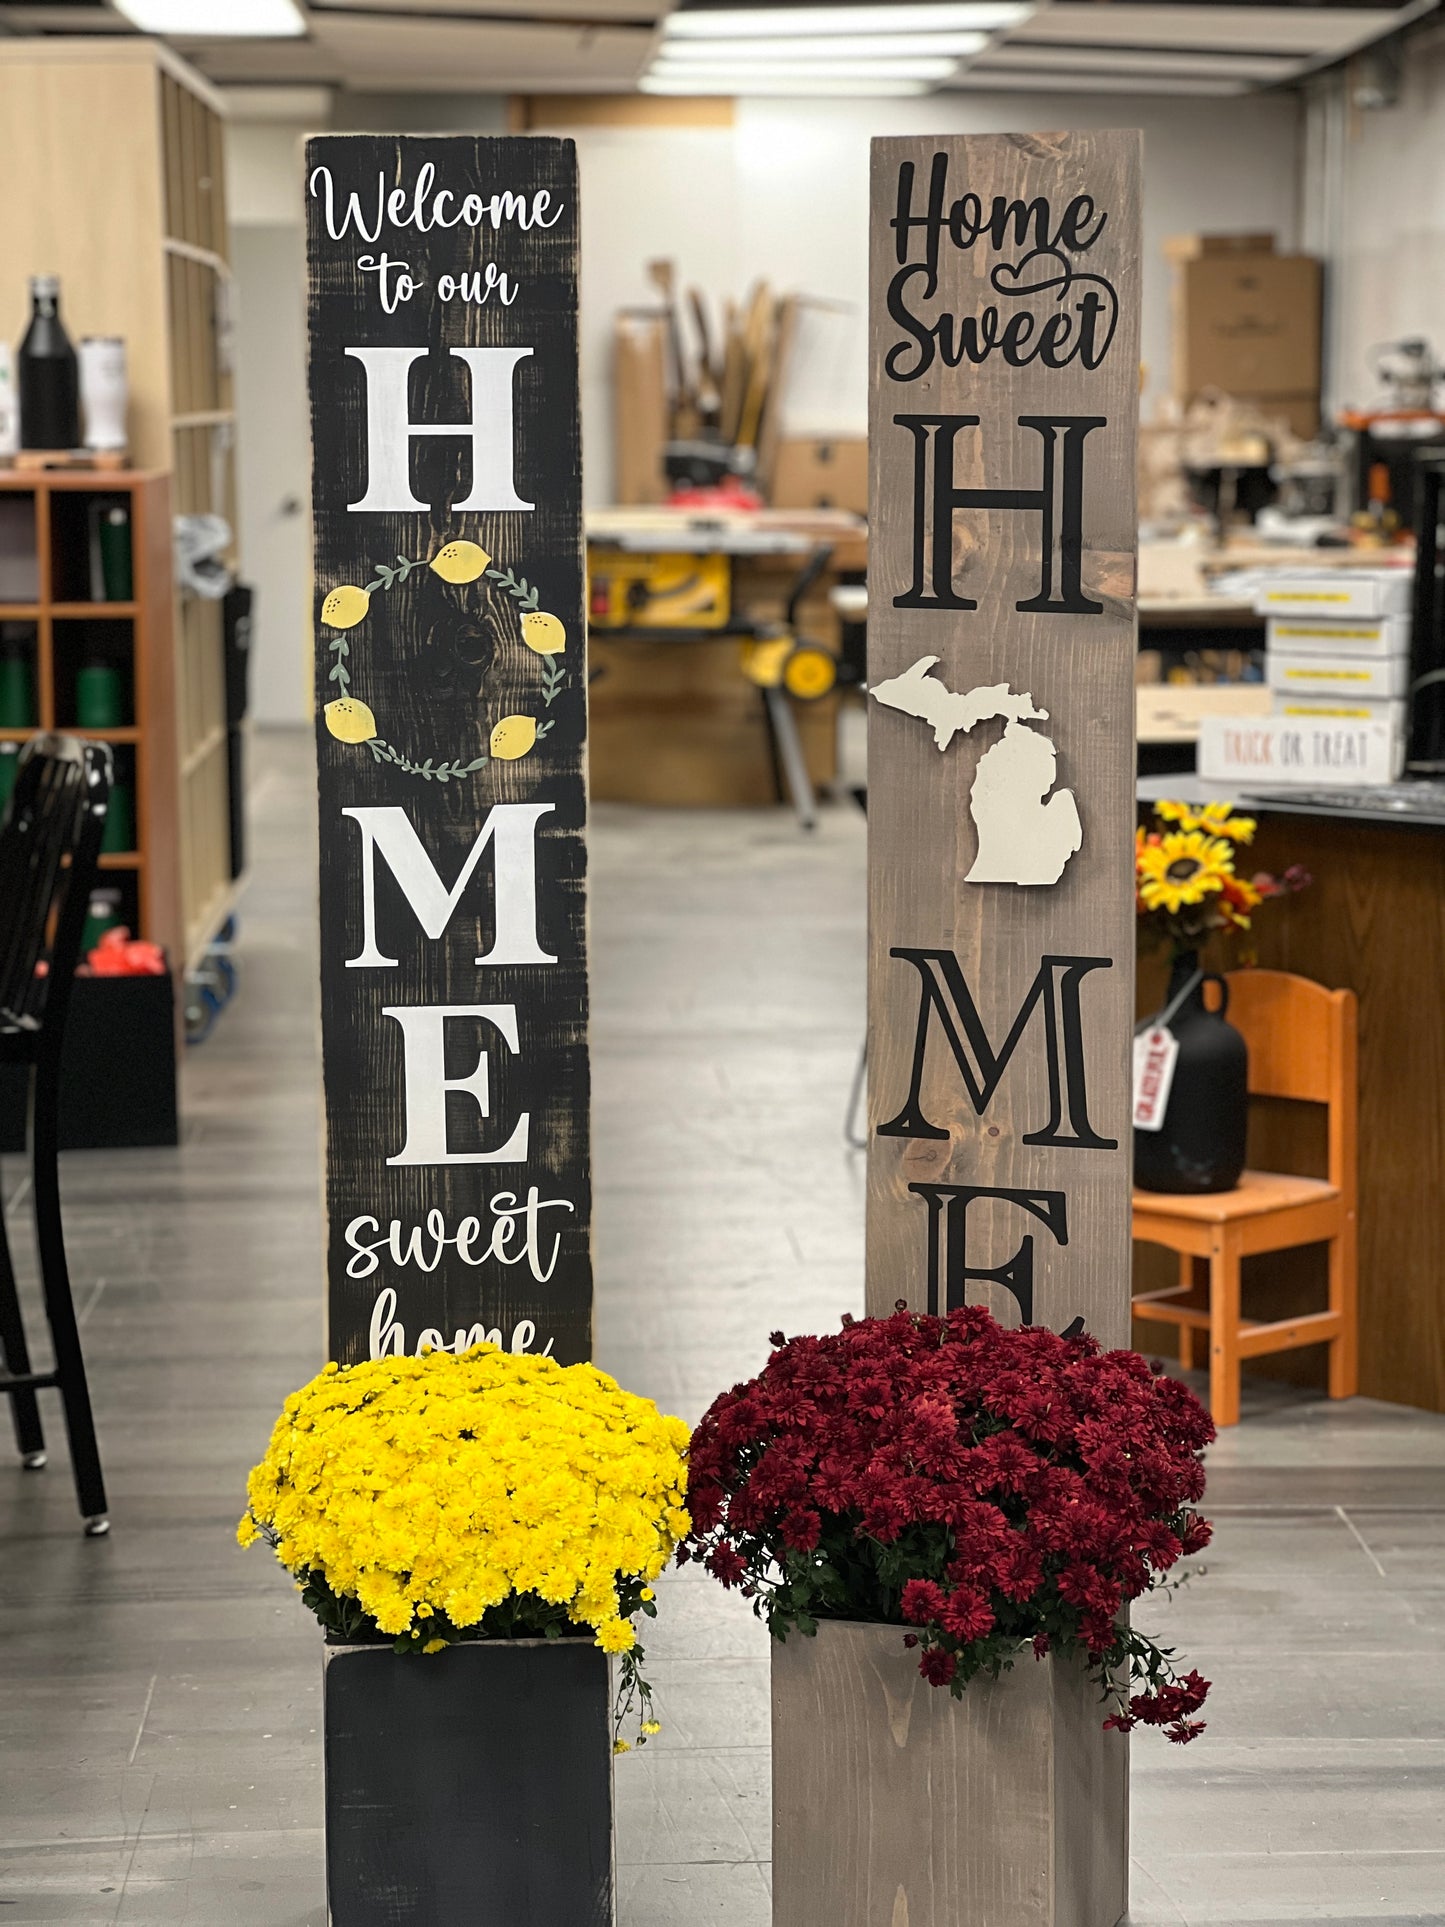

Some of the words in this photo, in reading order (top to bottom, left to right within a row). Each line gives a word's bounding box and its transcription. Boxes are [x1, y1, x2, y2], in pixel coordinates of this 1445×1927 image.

[309, 162, 565, 243] Welcome
[890, 152, 1108, 275] Home
[357, 252, 424, 314] to
[437, 263, 519, 306] our
[885, 250, 1119, 382] Sweet
[1224, 730, 1274, 767] TRICK
[1279, 730, 1305, 768] OR
[1312, 731, 1369, 769] TREAT
[344, 1186, 575, 1283] sweet
